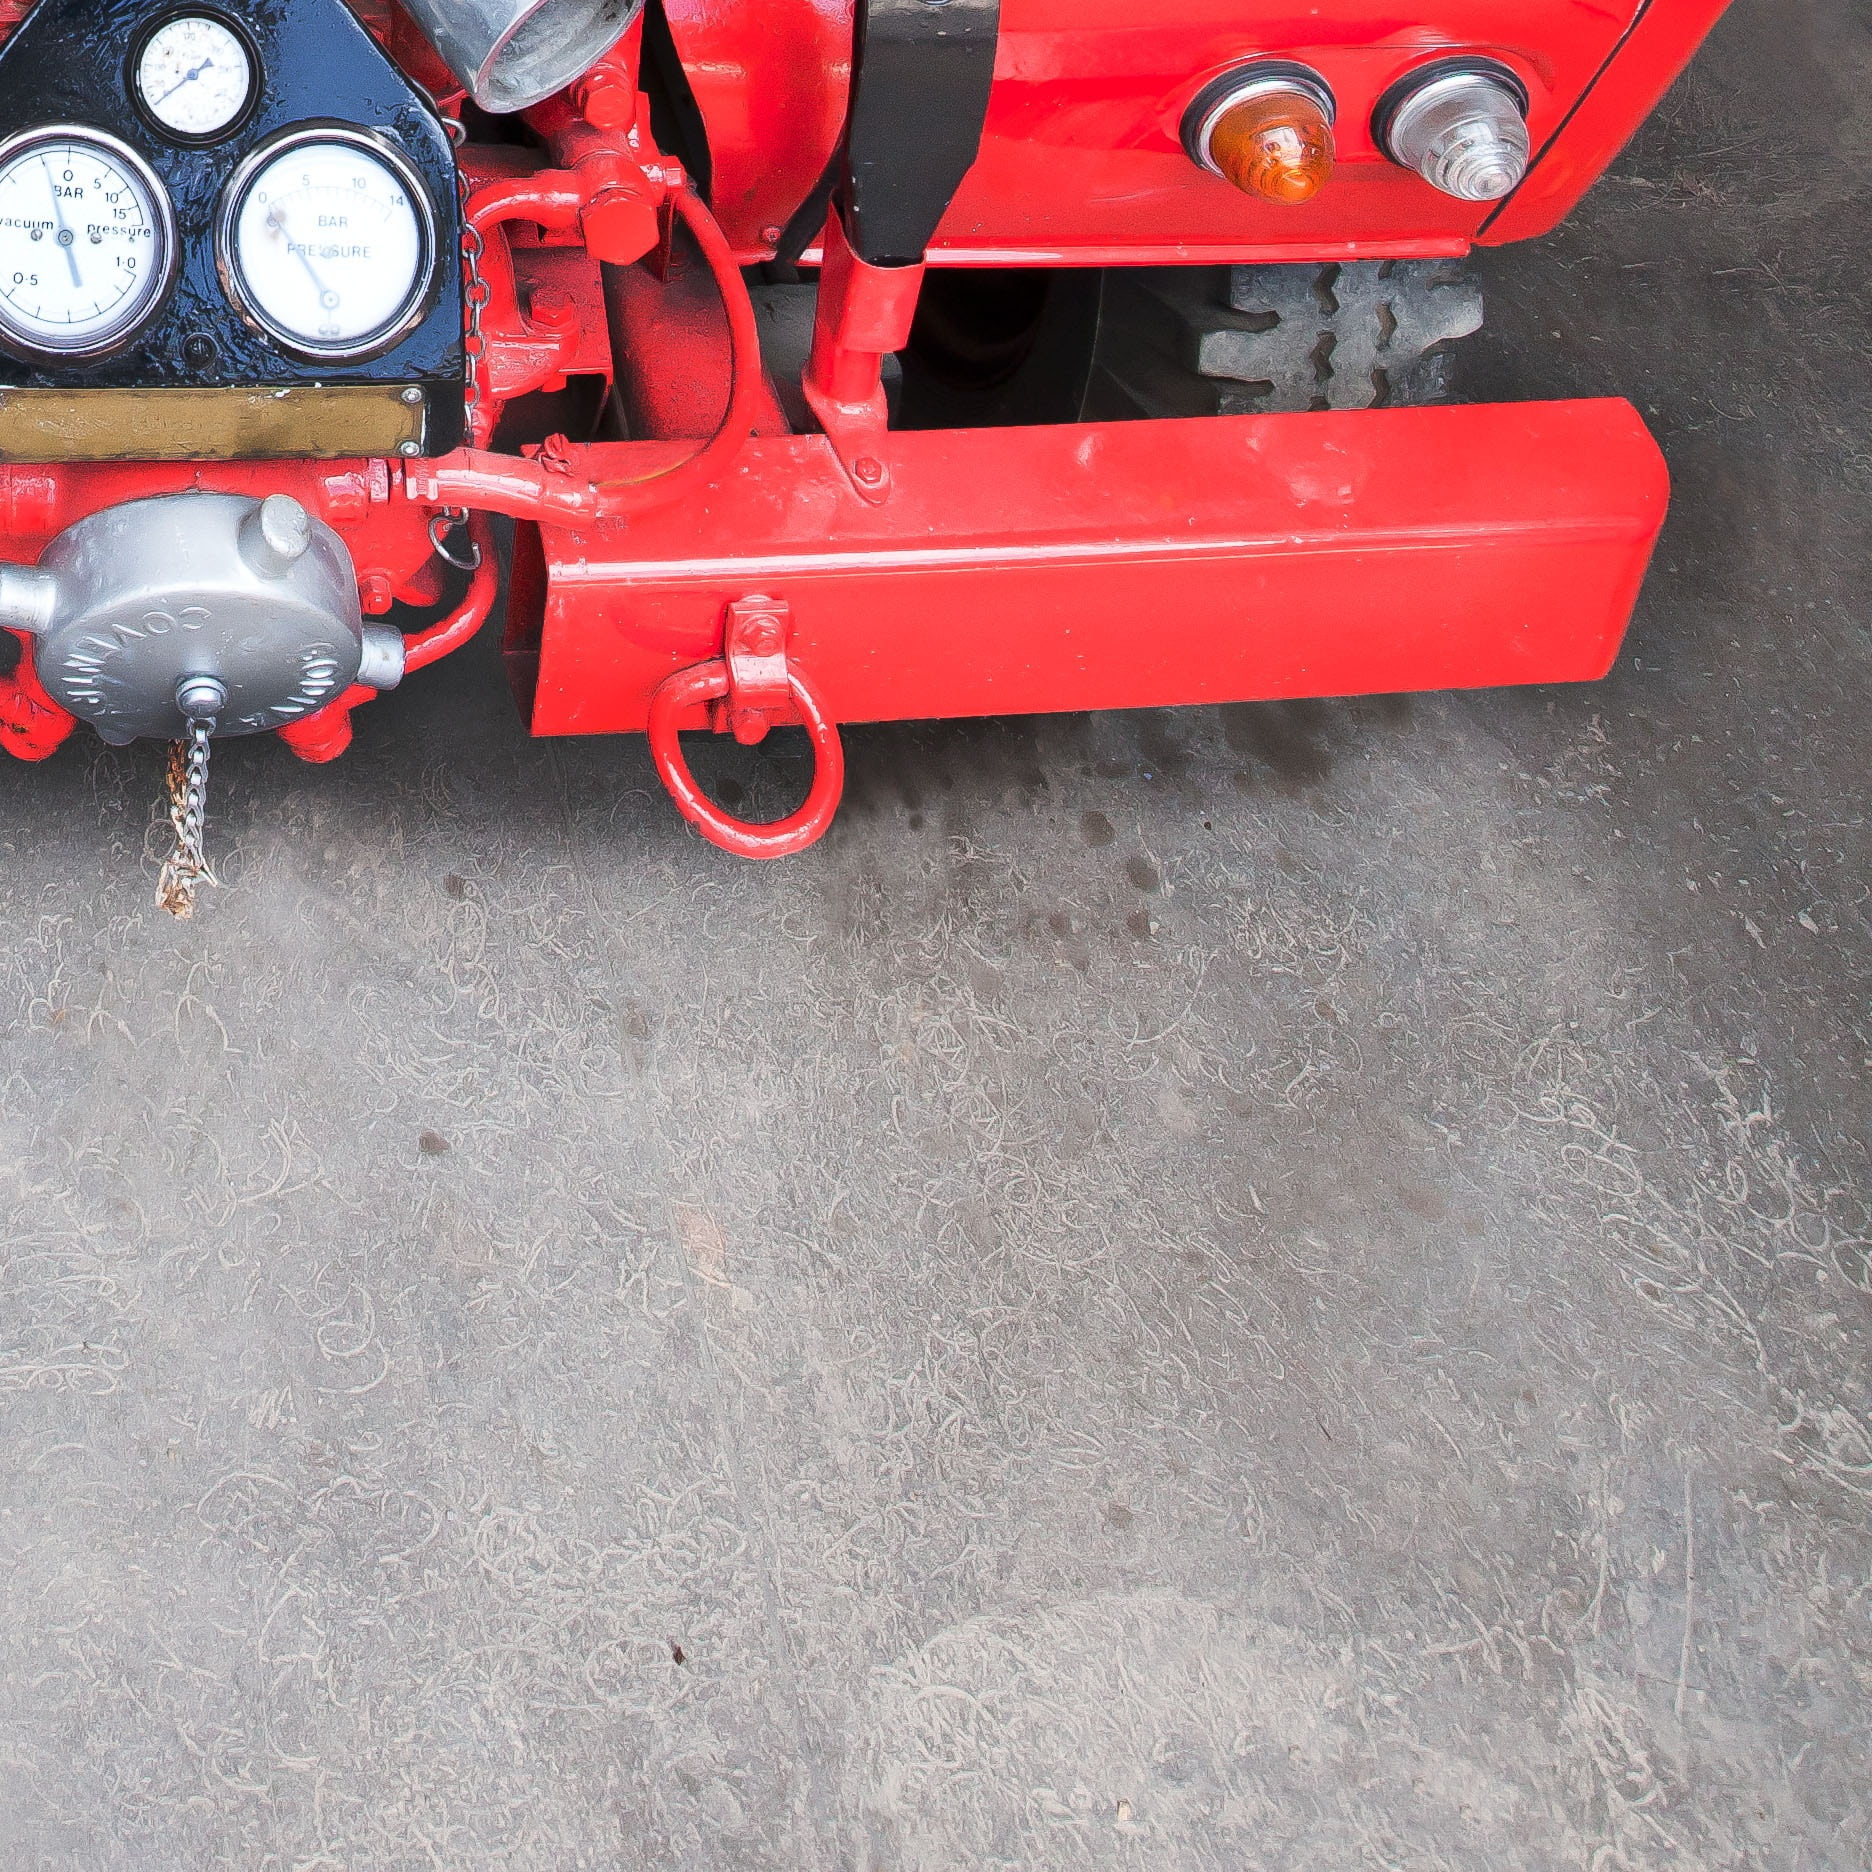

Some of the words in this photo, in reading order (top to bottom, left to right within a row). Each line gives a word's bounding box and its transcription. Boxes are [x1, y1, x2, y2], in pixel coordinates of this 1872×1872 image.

[62, 169, 74, 182] 0
[301, 174, 311, 187] 5
[93, 178, 102, 190] 5
[351, 177, 367, 190] 10
[54, 185, 84, 199] BAR
[105, 192, 120, 204] 10
[389, 194, 404, 207] 14
[112, 208, 127, 221] 15
[317, 215, 348, 228] BAR
[86, 223, 151, 239] pressure
